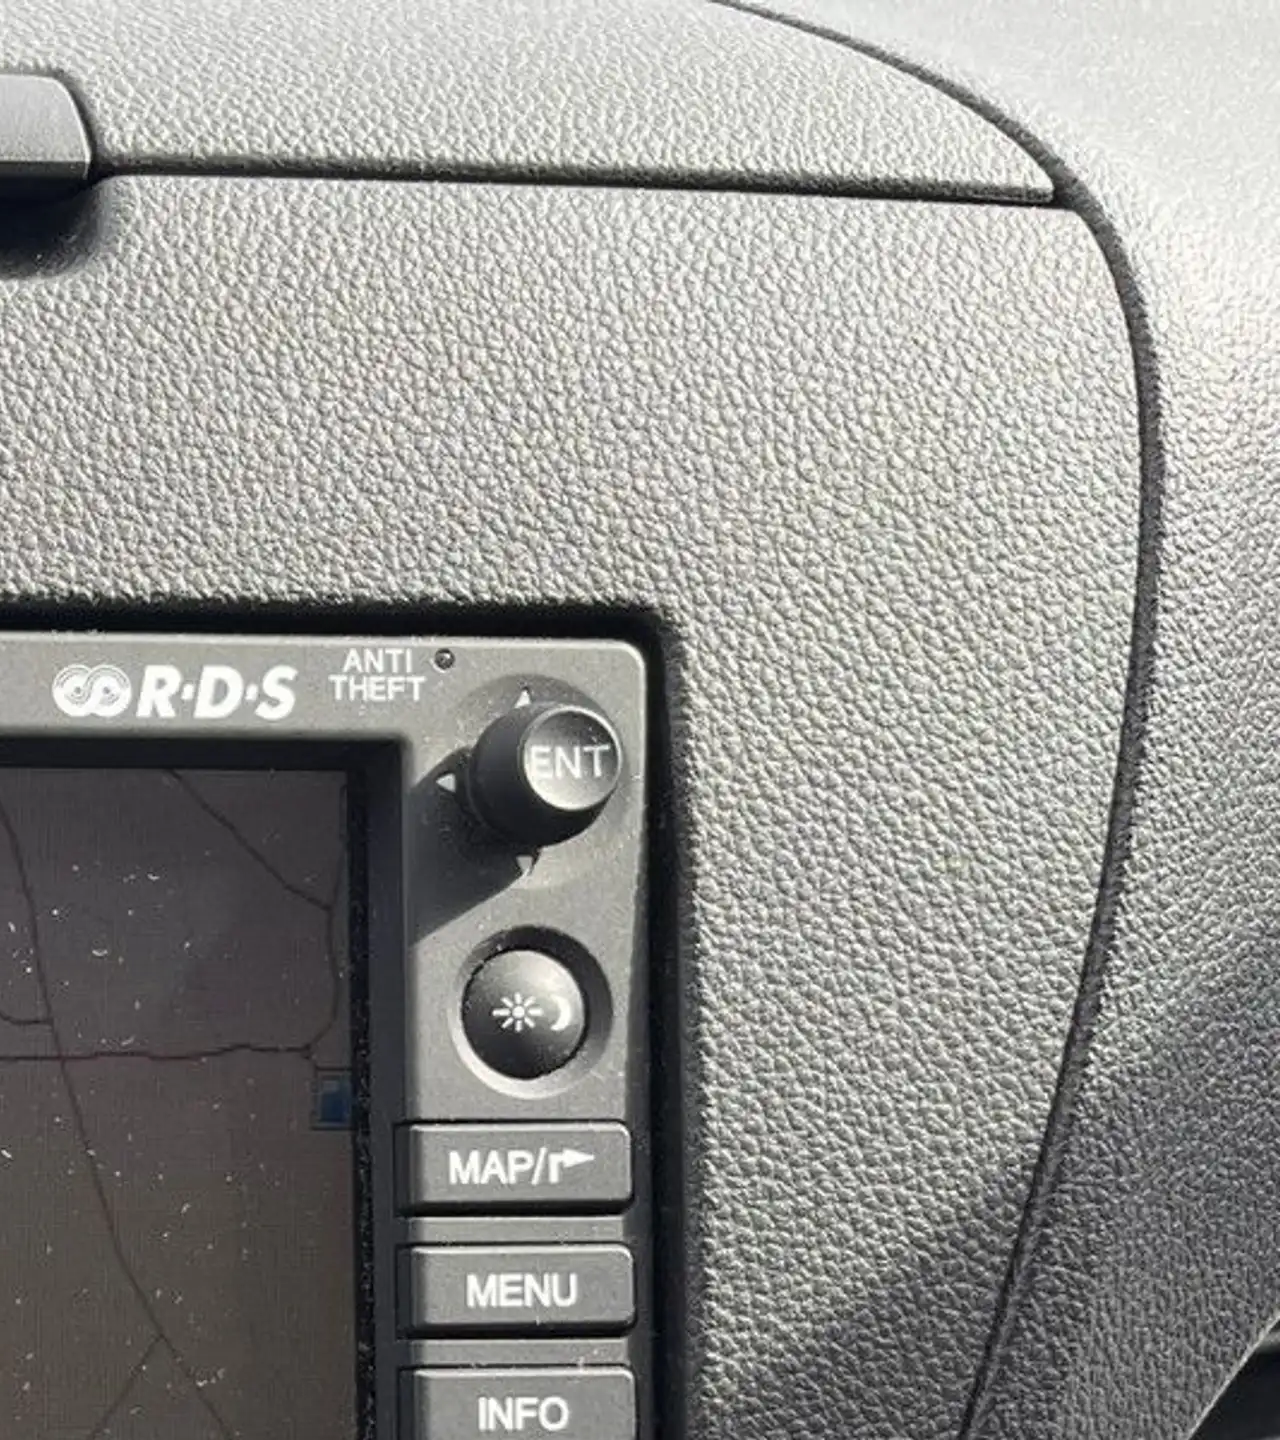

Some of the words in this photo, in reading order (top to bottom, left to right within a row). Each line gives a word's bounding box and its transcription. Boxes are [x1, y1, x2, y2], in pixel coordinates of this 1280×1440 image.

[343, 648, 413, 673] ANTI
[329, 675, 426, 702] THEFT
[529, 743, 611, 780] ENT
[467, 1274, 577, 1307] MENU
[478, 1397, 569, 1431] INFO
